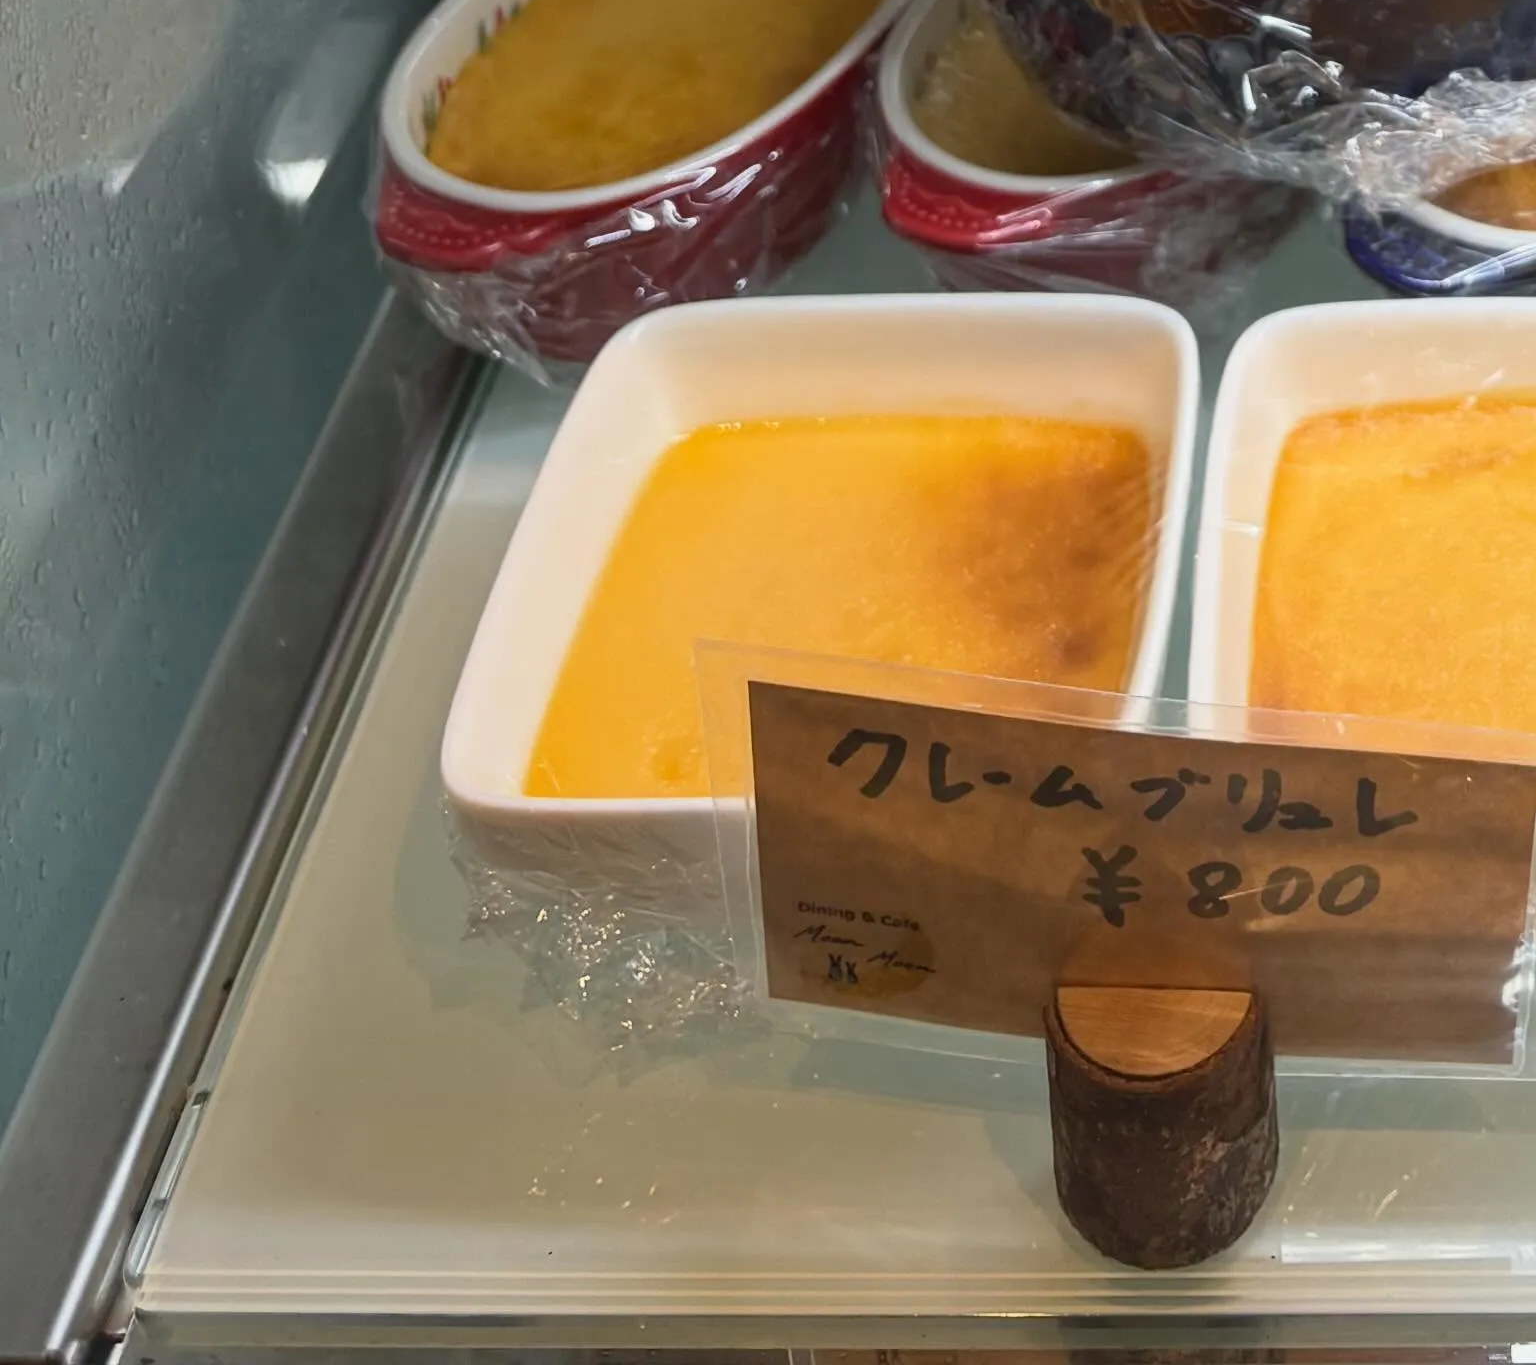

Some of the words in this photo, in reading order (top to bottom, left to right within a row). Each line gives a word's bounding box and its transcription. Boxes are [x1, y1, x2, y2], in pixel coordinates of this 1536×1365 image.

[827, 728, 1419, 837] クレームブリュレ
[797, 901, 855, 922] Dining
[1081, 846, 1382, 928] ¥800
